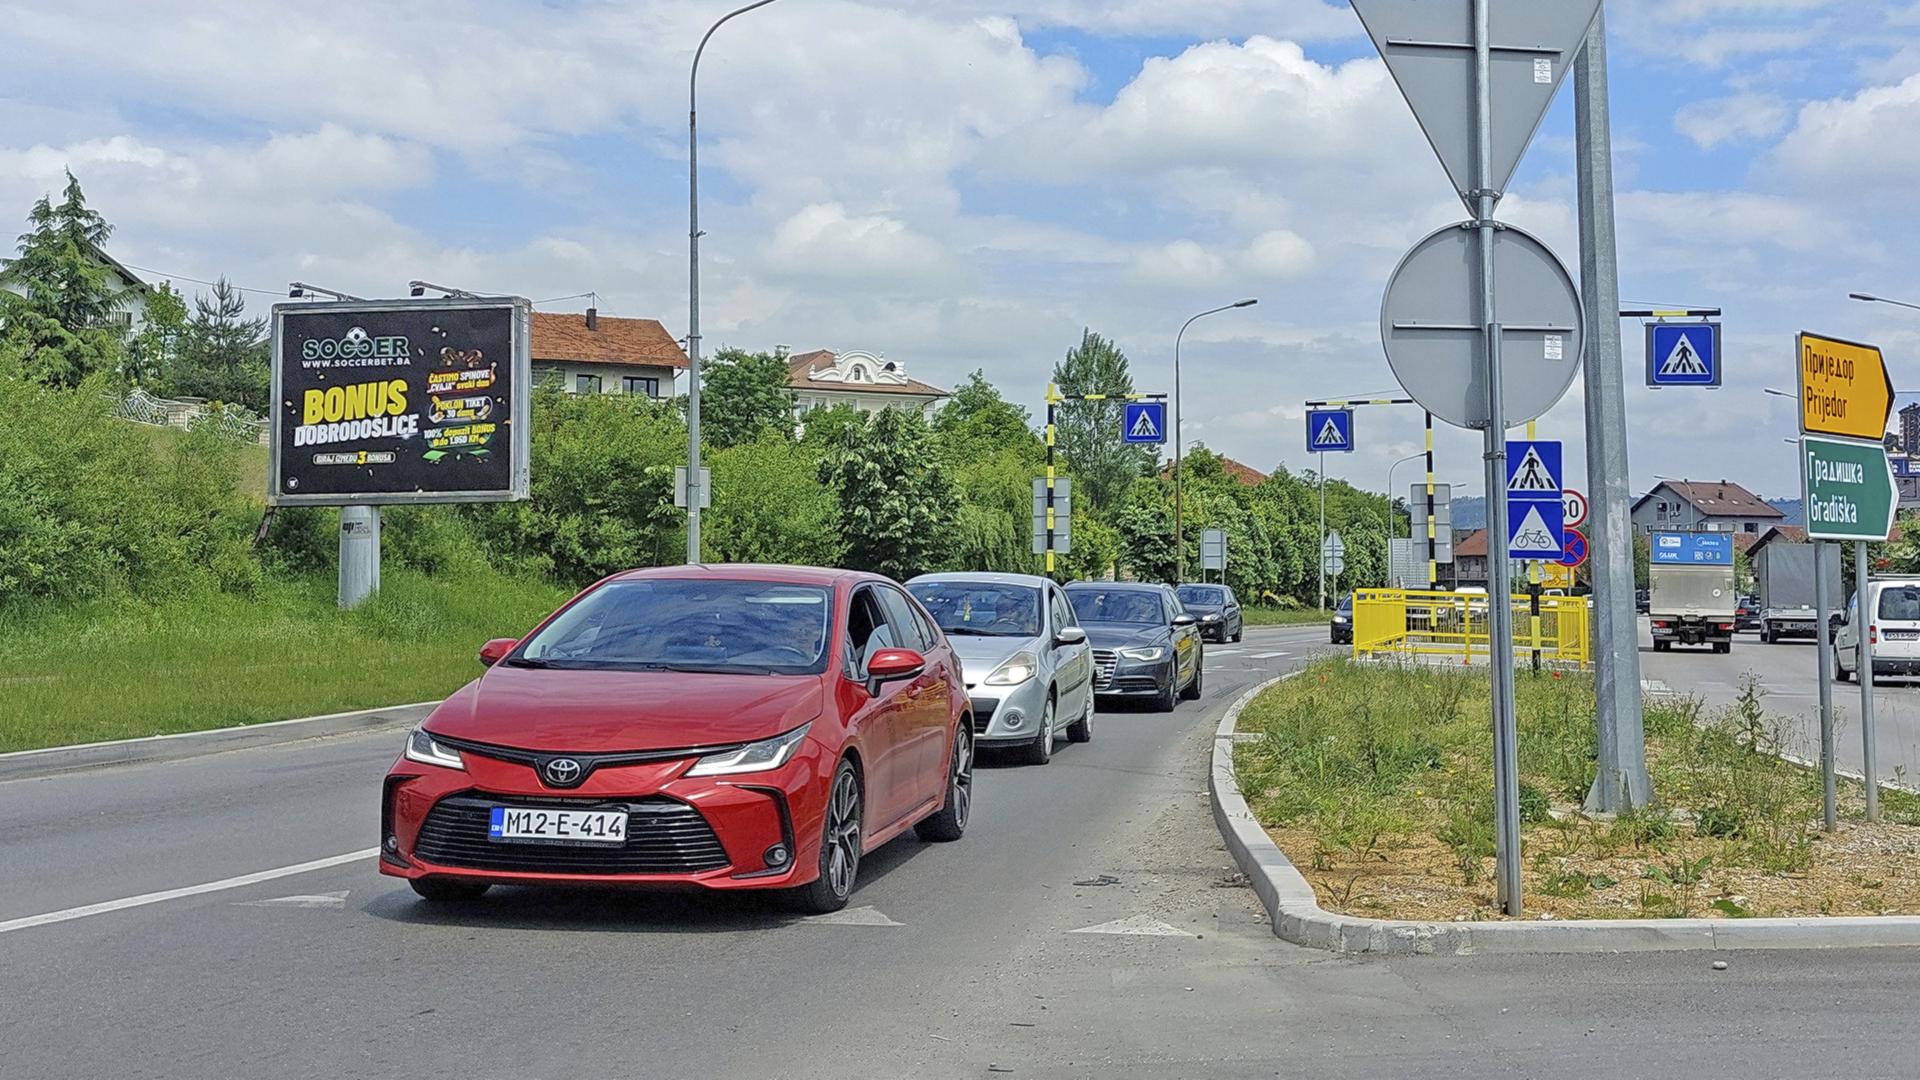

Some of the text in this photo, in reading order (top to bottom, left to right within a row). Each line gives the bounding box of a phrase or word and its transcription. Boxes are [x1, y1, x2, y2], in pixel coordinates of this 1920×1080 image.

[302, 336, 410, 359] SOCCER
[302, 358, 411, 367] WWW.SOCCERBET.BA
[1805, 345, 1854, 386] Приједор
[303, 379, 408, 424] BONUS
[1806, 386, 1847, 422] Prijedor
[294, 413, 419, 447] DOBRODOŠLICE
[357, 451, 368, 464] 3
[1808, 451, 1864, 488] Градишка
[1810, 493, 1857, 524] Gradiška
[506, 811, 622, 838] M12-E-414
